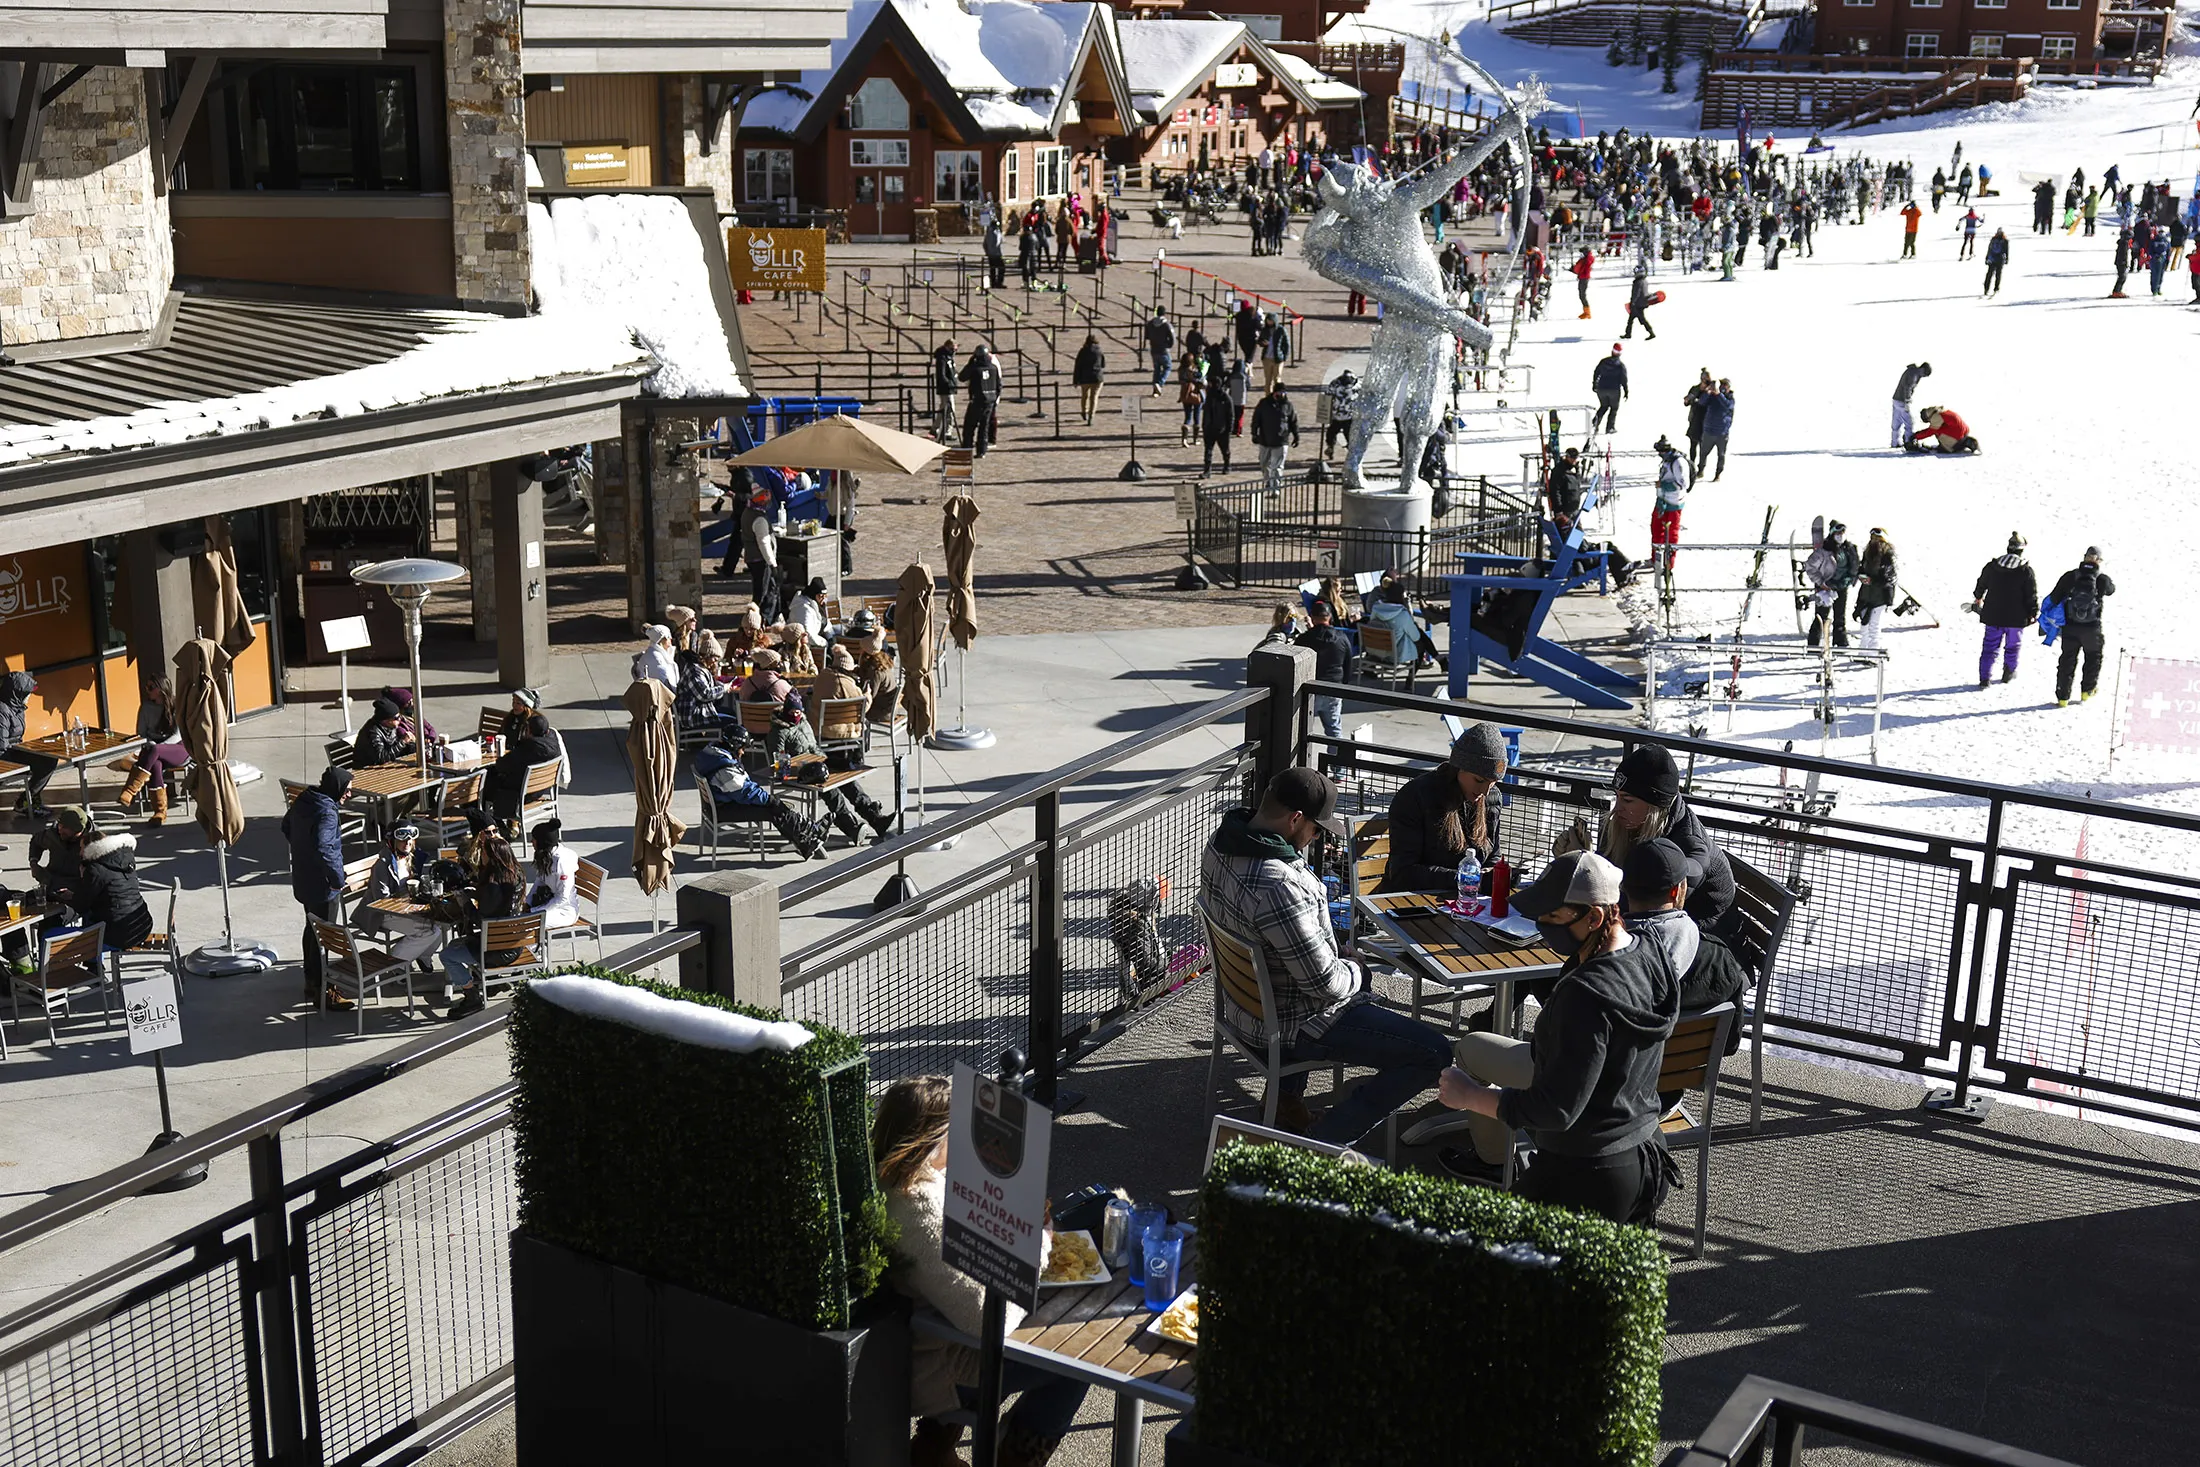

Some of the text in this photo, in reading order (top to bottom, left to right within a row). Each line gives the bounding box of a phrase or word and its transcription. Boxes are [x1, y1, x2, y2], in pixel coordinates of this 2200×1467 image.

[952, 1180, 1034, 1237] RESTAURANT
[983, 1179, 1004, 1201] NO
[967, 1209, 1015, 1246] ACCESS
[957, 1256, 971, 1272] SEE
[971, 1265, 992, 1283] HOST
[960, 1231, 1019, 1272] FOR SEATING AT
[976, 1254, 1005, 1278] TAVERN
[1005, 1272, 1034, 1296] PLEASE
